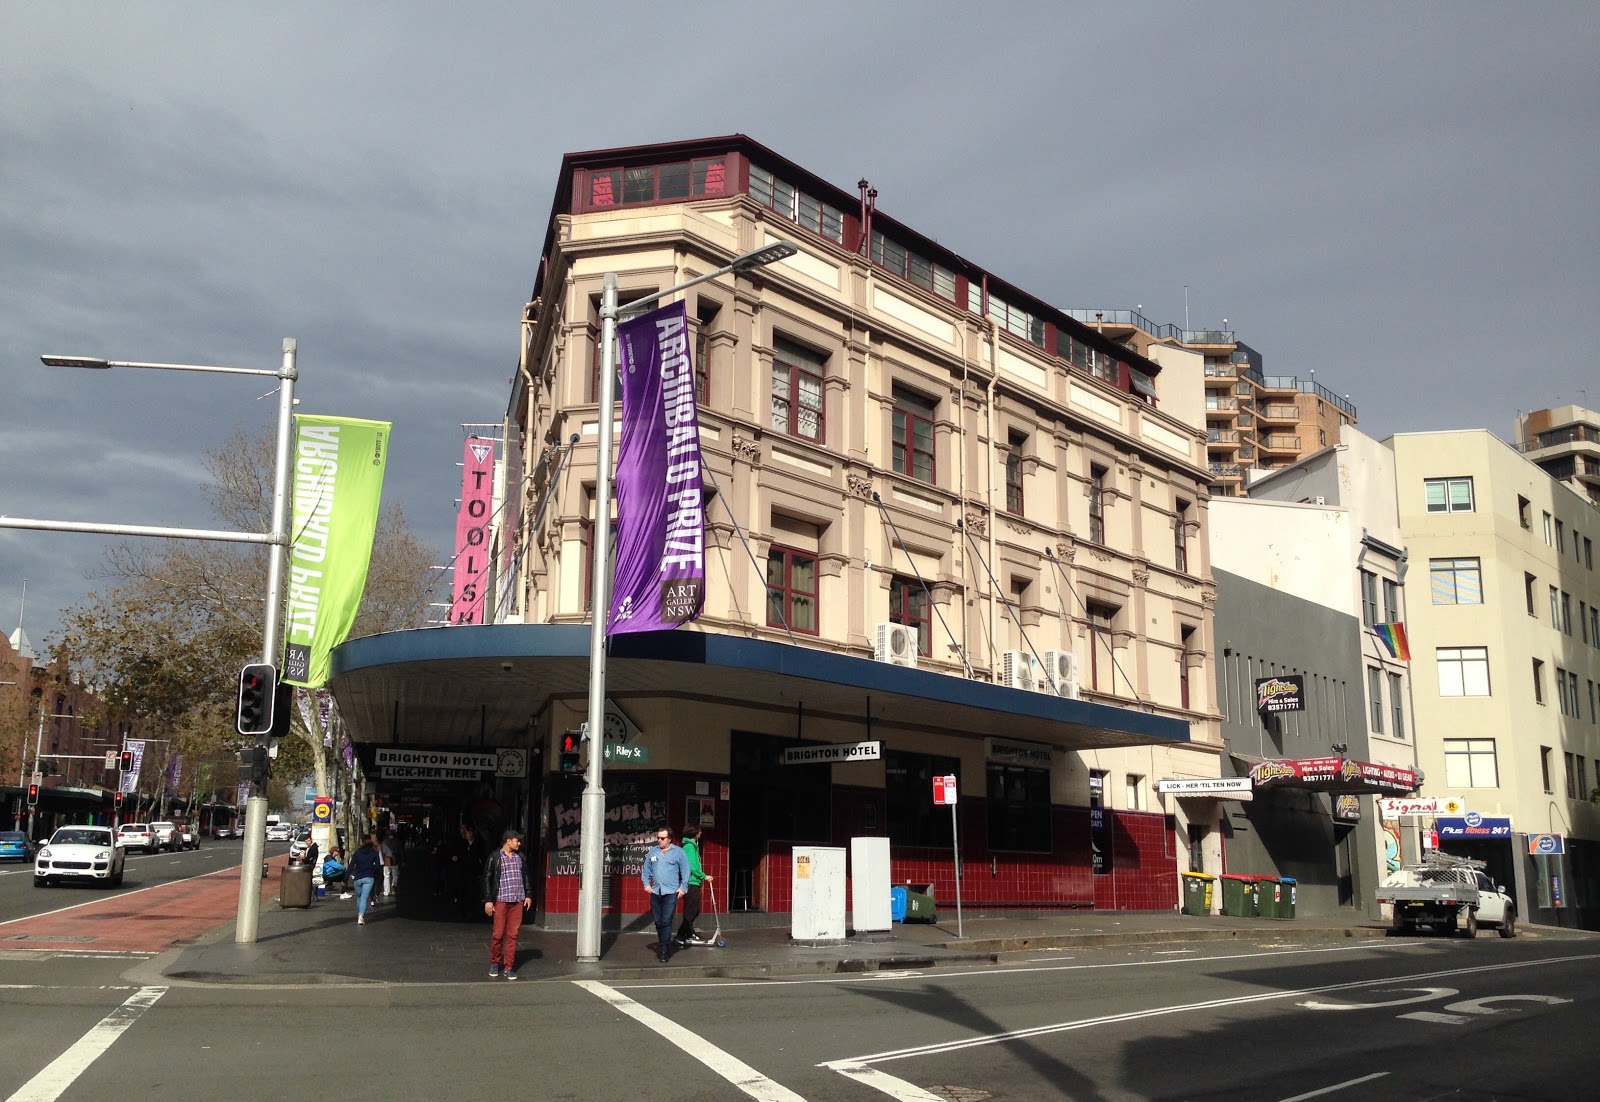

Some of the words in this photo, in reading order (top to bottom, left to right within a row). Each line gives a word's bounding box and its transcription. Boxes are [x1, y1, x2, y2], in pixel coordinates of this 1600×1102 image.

[656, 315, 700, 484] ARCHIBALD
[661, 488, 702, 572] PRIZE
[667, 584, 697, 598] ART
[666, 597, 696, 606] GALLERY
[667, 605, 697, 617] NSW
[616, 745, 633, 758] Riley
[634, 747, 641, 757] St
[787, 748, 839, 760] BRIGHTON
[843, 746, 877, 757] HOTEL
[1030, 750, 1051, 760] HOTEL
[379, 752, 448, 765] BRIGHTON
[453, 756, 494, 767] HOTEL
[385, 767, 442, 778] LICK-HER
[446, 769, 477, 778] HERE
[1362, 766, 1380, 777] LIGHTING
[1384, 770, 1394, 779] AUDIO
[1402, 773, 1413, 782] GEAR
[1387, 800, 1437, 815] Signal
[1441, 826, 1464, 834] Plus
[1464, 826, 1490, 834] fitness
[1491, 826, 1509, 834] 24/7
